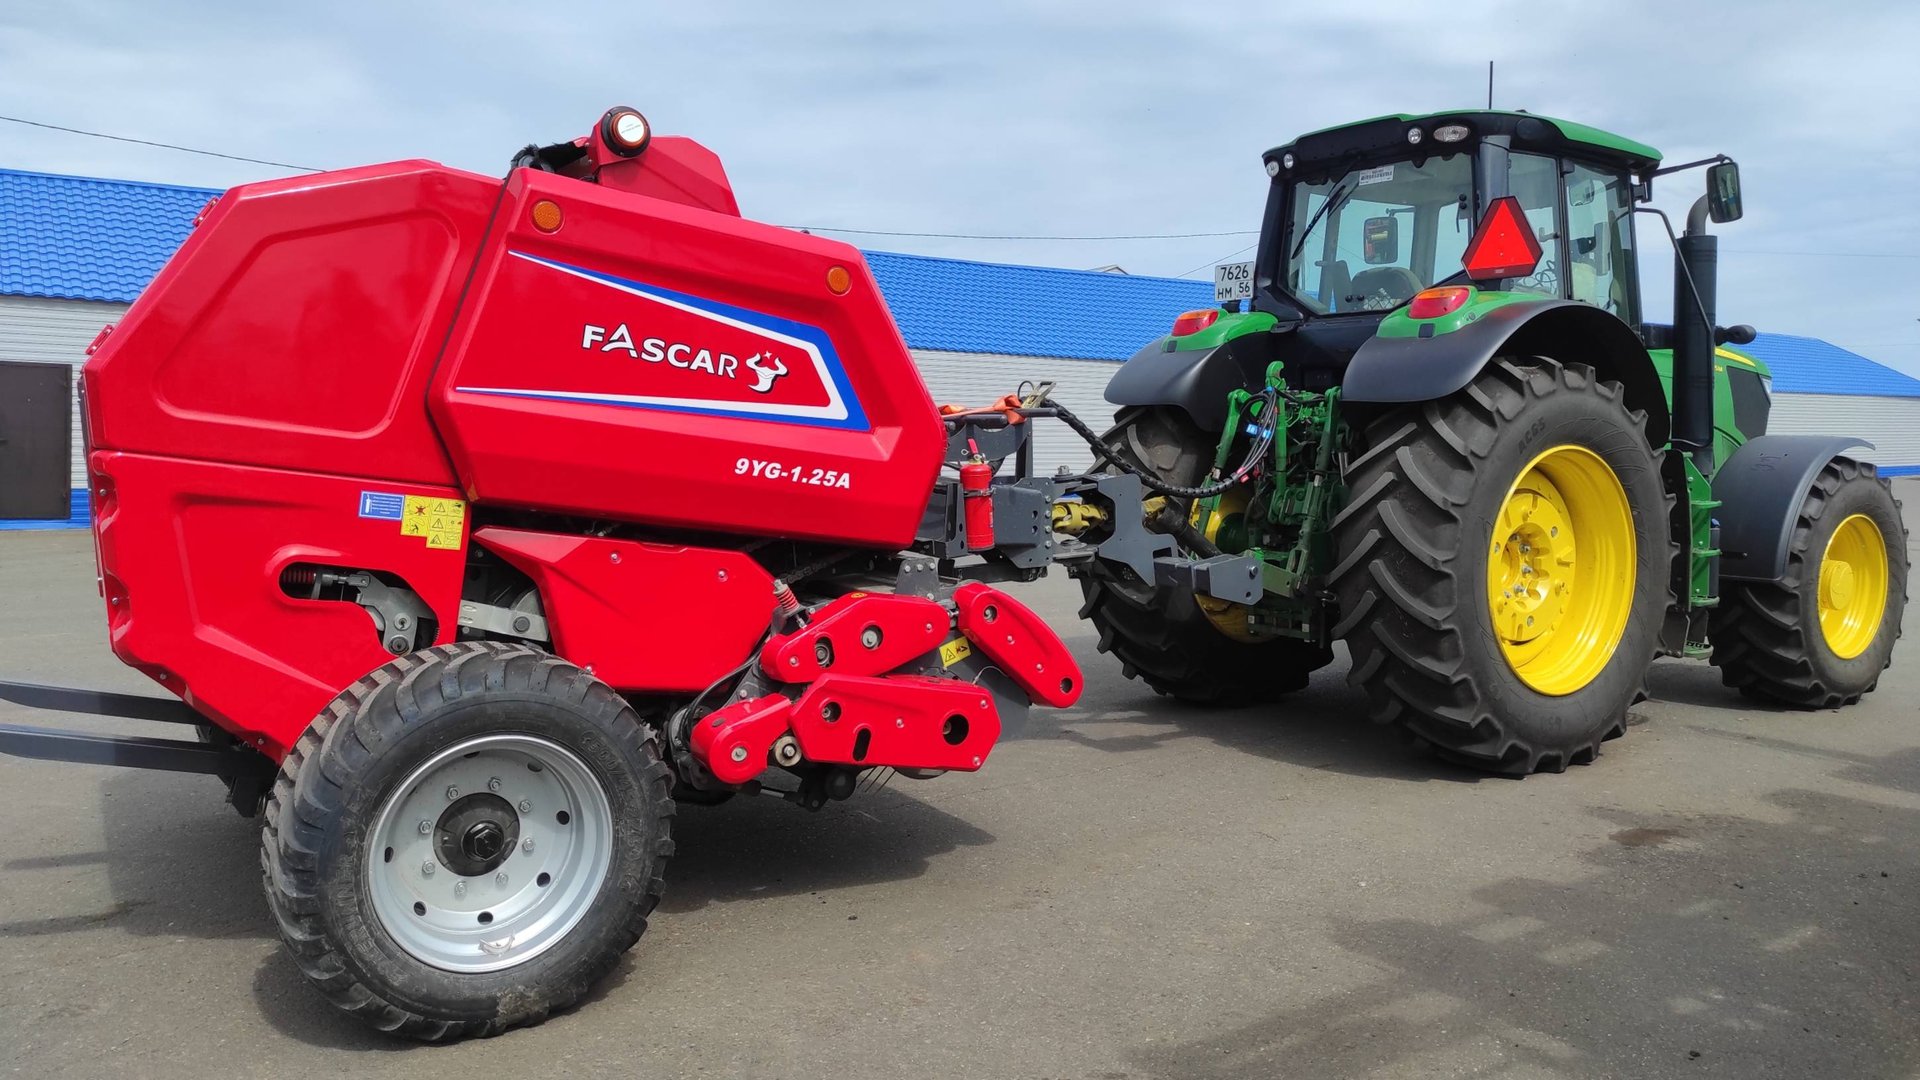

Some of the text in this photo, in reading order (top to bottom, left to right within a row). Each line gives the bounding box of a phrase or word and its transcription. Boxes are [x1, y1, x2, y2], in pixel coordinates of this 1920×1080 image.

[1220, 264, 1249, 281] 7626
[1238, 282, 1250, 294] 56
[581, 323, 739, 379] FASCAR
[734, 458, 851, 489] 9YG-1.25A
